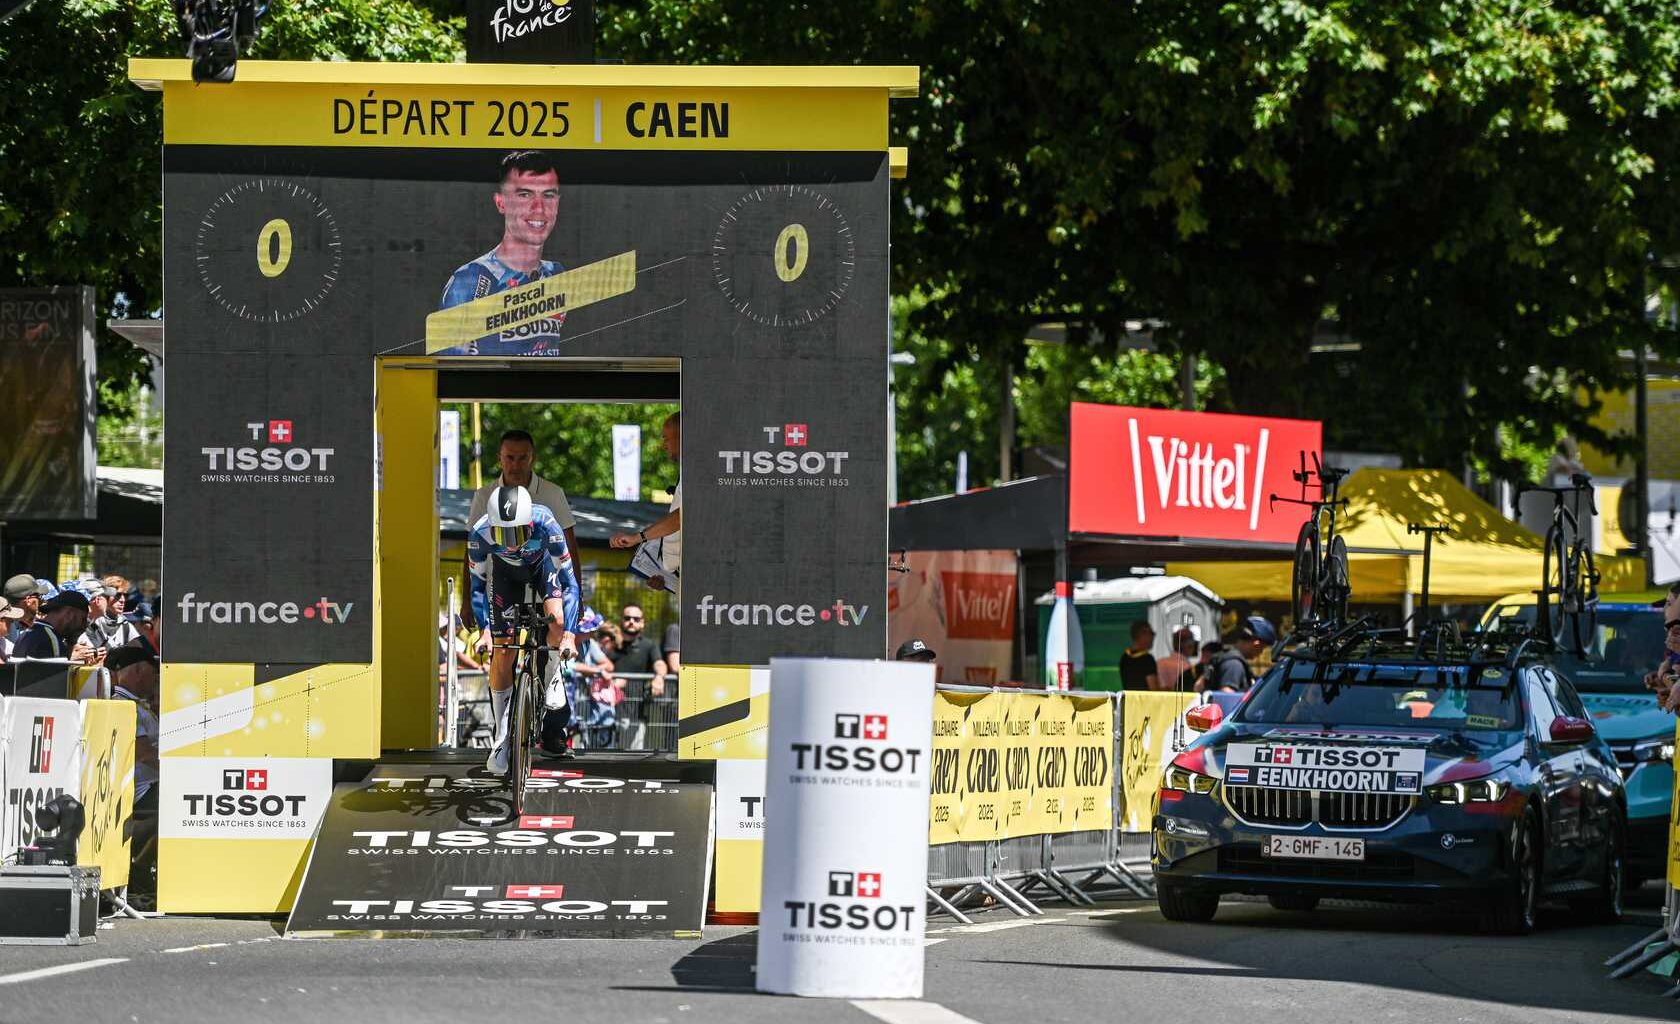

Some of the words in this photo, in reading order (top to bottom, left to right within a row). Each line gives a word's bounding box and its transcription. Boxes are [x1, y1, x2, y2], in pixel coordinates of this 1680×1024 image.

[333, 89, 475, 136] DÉPART
[487, 100, 570, 137] 2025
[625, 101, 729, 138] CAEN
[257, 218, 292, 277] 0
[774, 223, 809, 282] 0
[503, 282, 545, 308] Pascal
[485, 293, 566, 331] EENKHOORN
[201, 447, 335, 471] TISSOT
[718, 451, 849, 474] TISSOT
[201, 474, 231, 483] SWISS
[234, 474, 282, 483] WATCHES
[282, 475, 311, 483] SINCE
[314, 475, 335, 483] 1853
[718, 477, 747, 486] SWISS
[750, 477, 794, 486] WATCHES
[797, 478, 825, 486] SINCE
[829, 478, 849, 487] 1853
[1147, 435, 1247, 510] Vittel
[957, 586, 1002, 622] Vittel
[790, 743, 922, 774] TISSOT
[1296, 749, 1401, 768] TISSOT
[789, 775, 819, 785] SWISS
[820, 776, 873, 787] WATCHES
[875, 778, 903, 788] SINCE
[1256, 767, 1389, 791] EENKHOORN
[183, 794, 306, 817] TISSOT
[182, 819, 210, 828] SWISS
[212, 819, 255, 828] WATCHES
[257, 820, 284, 828] SINCE
[286, 820, 306, 828] 1853
[352, 830, 675, 847] TISSOT
[332, 900, 668, 914] TISSOT
[784, 900, 915, 931] TISSOT
[782, 933, 811, 943] SWISS
[815, 934, 866, 945] WATCHES
